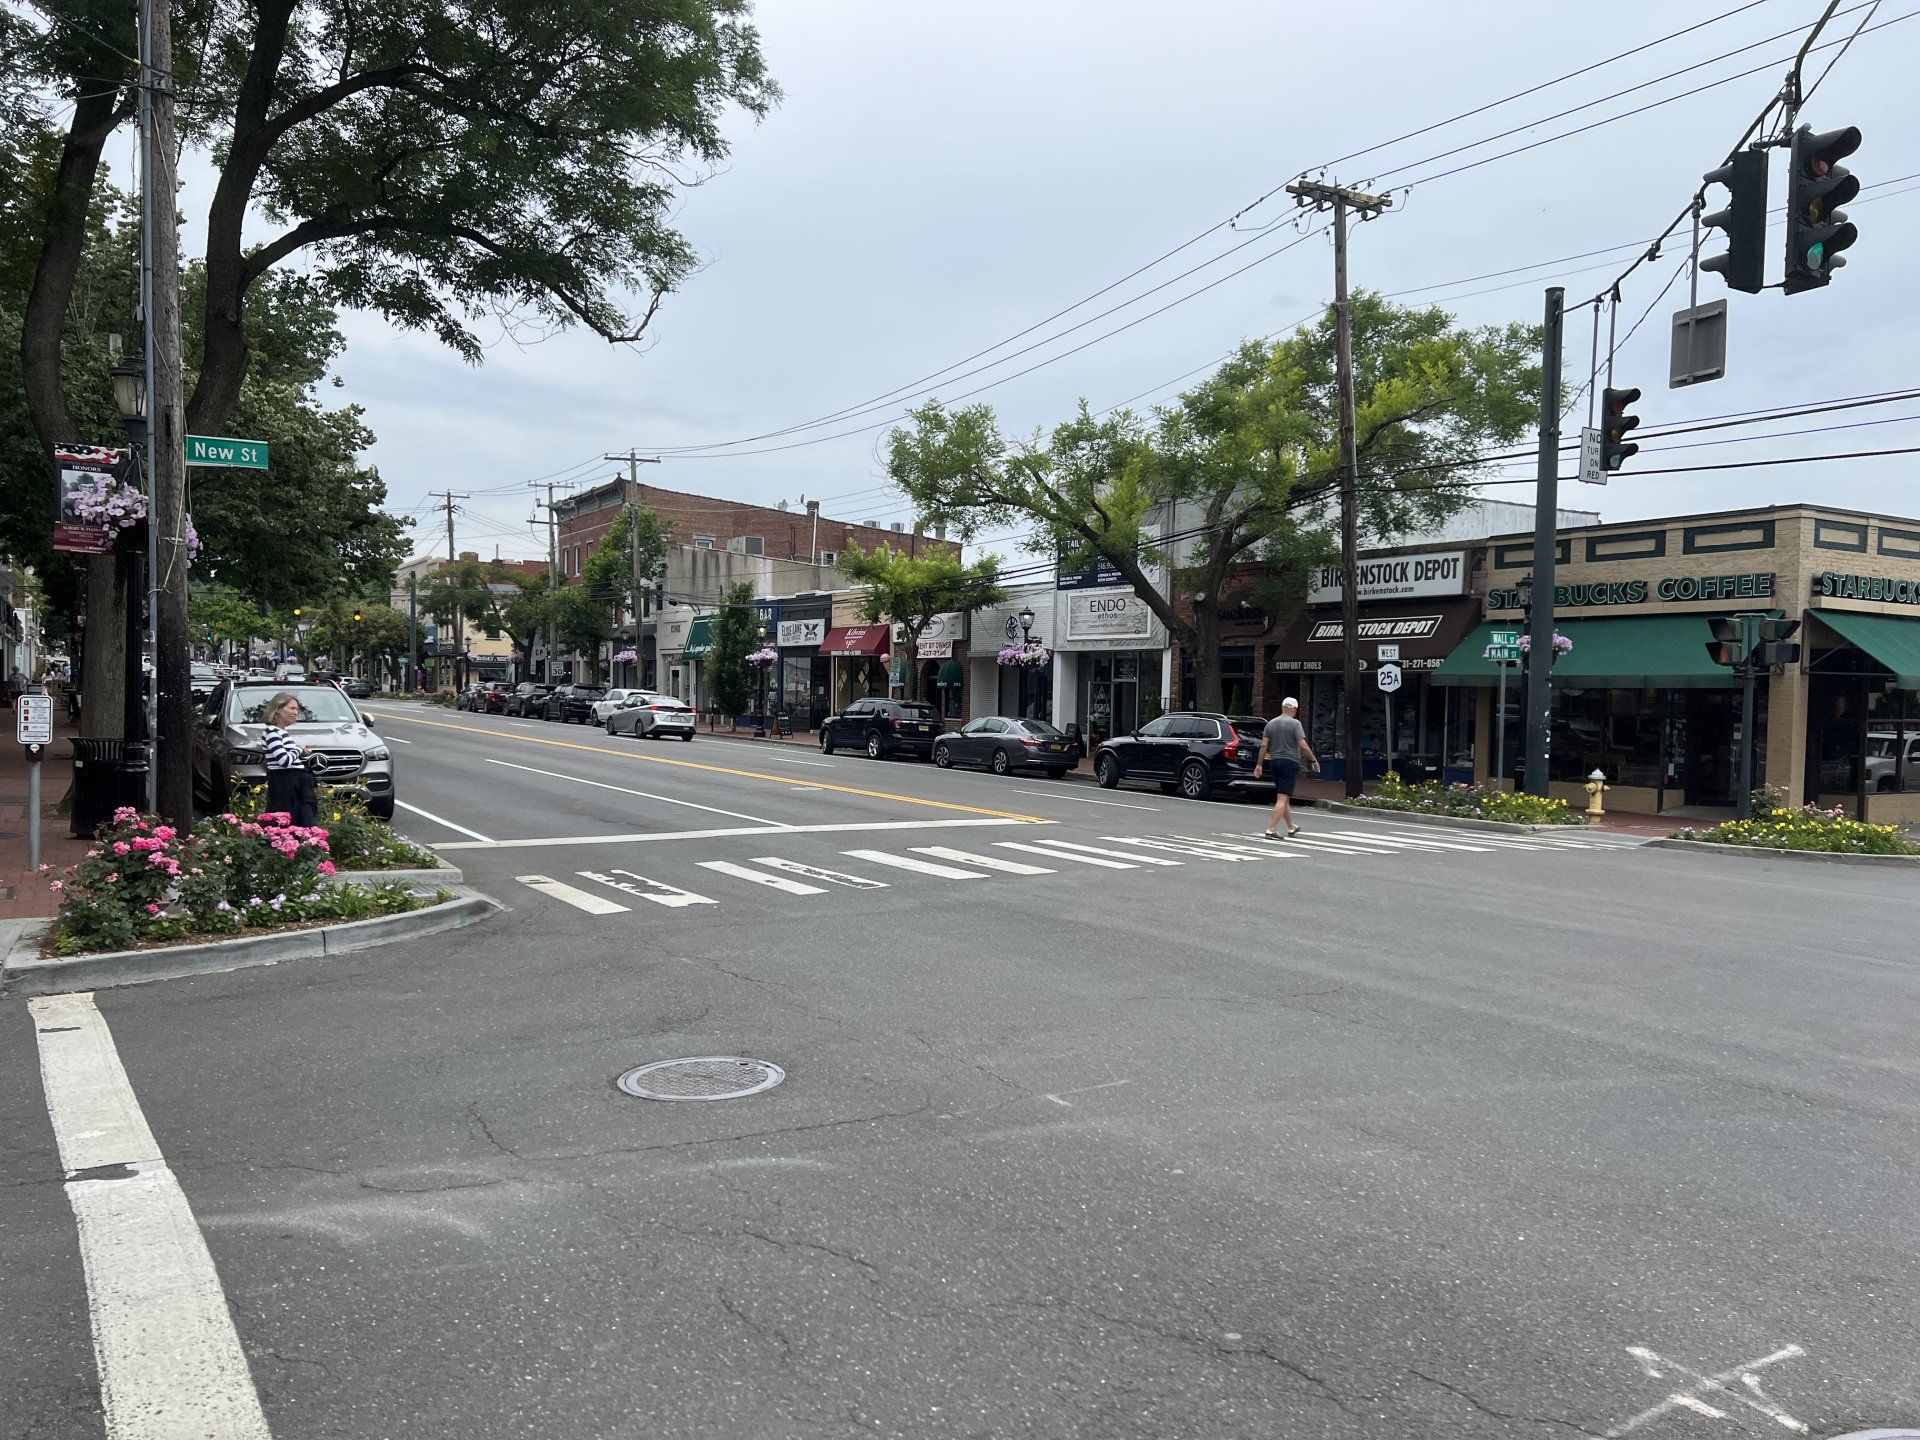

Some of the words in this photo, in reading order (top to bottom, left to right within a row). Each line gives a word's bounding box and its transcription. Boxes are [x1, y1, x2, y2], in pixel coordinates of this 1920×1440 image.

[1590, 433, 1601, 443] NO
[194, 441, 234, 460] New
[241, 447, 257, 462] St
[1587, 446, 1598, 455] TUR
[72, 464, 101, 472] HONORS
[1590, 459, 1598, 467] ON
[1587, 471, 1599, 480] RED
[1321, 562, 1409, 588] BIRNSTOCK
[1414, 558, 1459, 582] DEPOT
[1357, 586, 1414, 596] w.birkenstock.com
[1487, 580, 1645, 609] STBUCKS
[1656, 572, 1772, 600] COFFEE
[1090, 598, 1126, 612] ENDO
[760, 608, 772, 620] BAR
[1315, 622, 1395, 637] BIRKSTOCK
[1392, 621, 1434, 634] DEPOT
[1493, 634, 1508, 644] WALL
[1381, 649, 1396, 658] WEST
[1491, 649, 1508, 659] MAIN
[1276, 662, 1301, 670] COMFORT
[1303, 661, 1321, 670] SHOES
[1380, 672, 1399, 685] 25A
